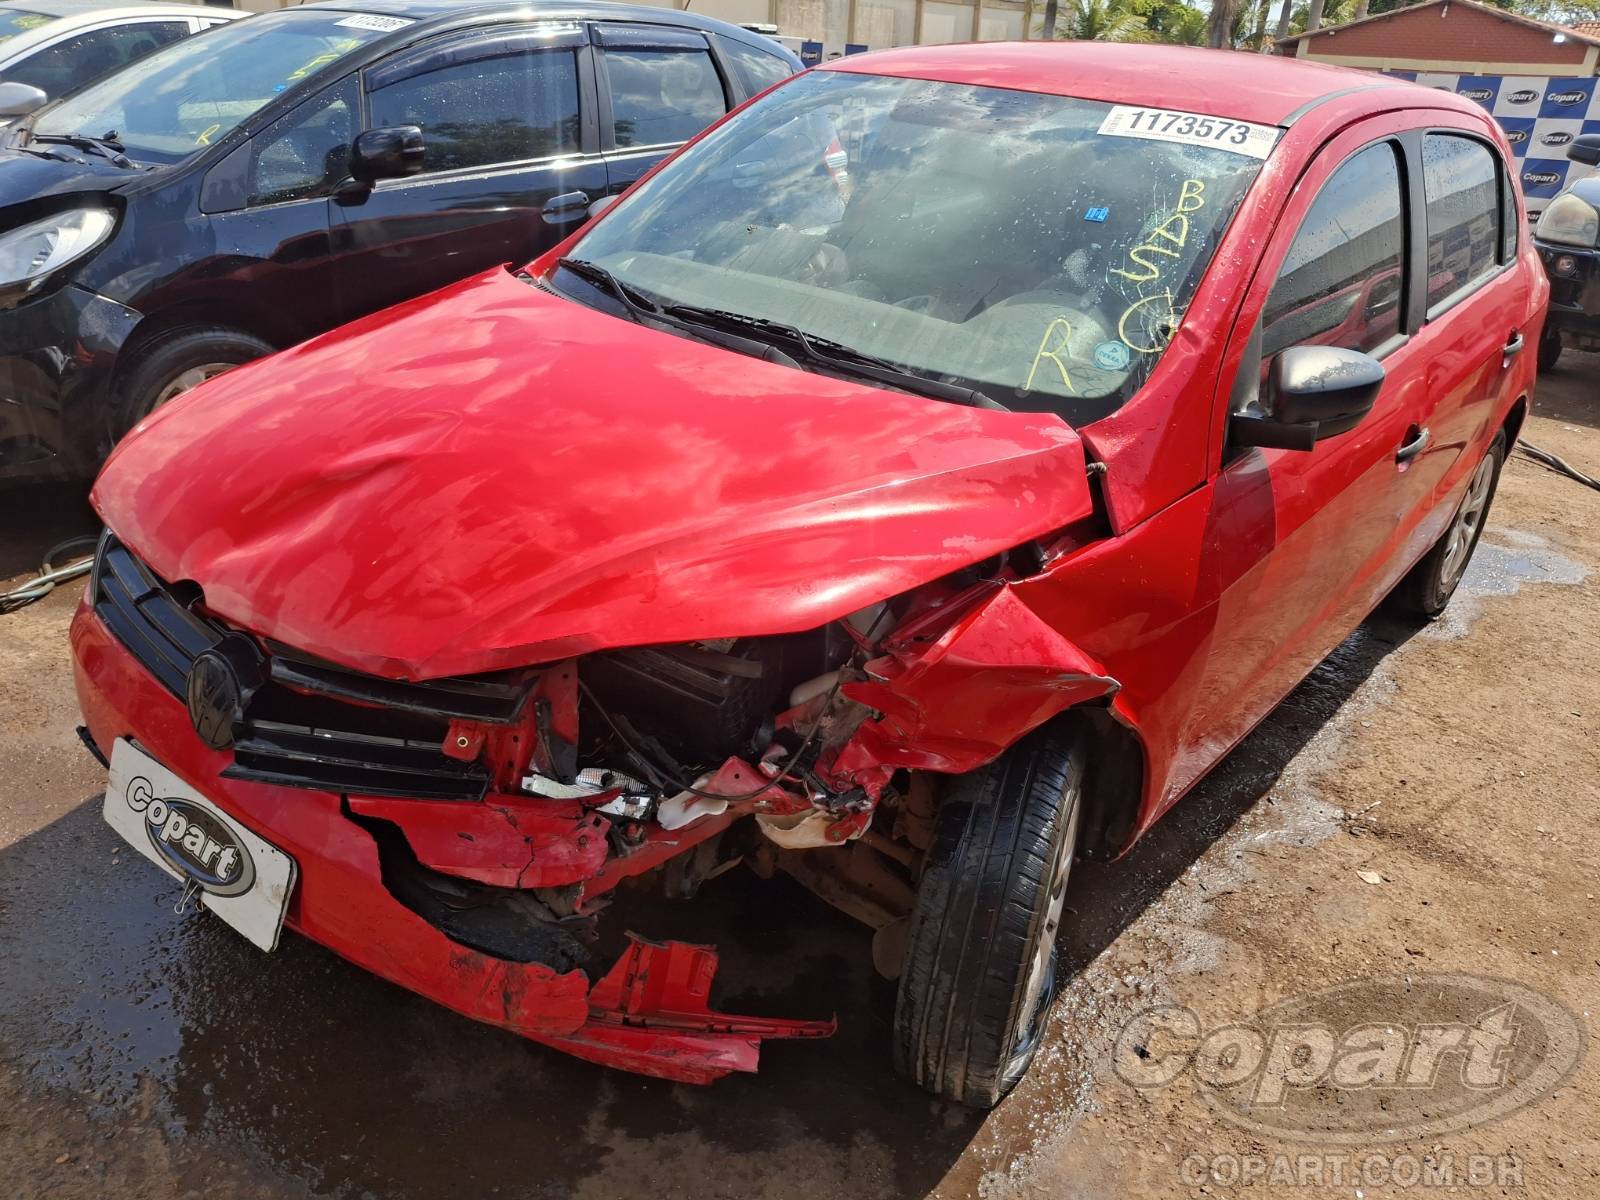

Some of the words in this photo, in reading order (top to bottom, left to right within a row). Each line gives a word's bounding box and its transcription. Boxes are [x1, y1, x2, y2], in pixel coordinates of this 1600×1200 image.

[1547, 92, 1582, 104] Copart
[1129, 110, 1250, 145] 1173573
[1523, 173, 1556, 184] Copart
[1023, 318, 1076, 394] R
[126, 775, 238, 881] Copart
